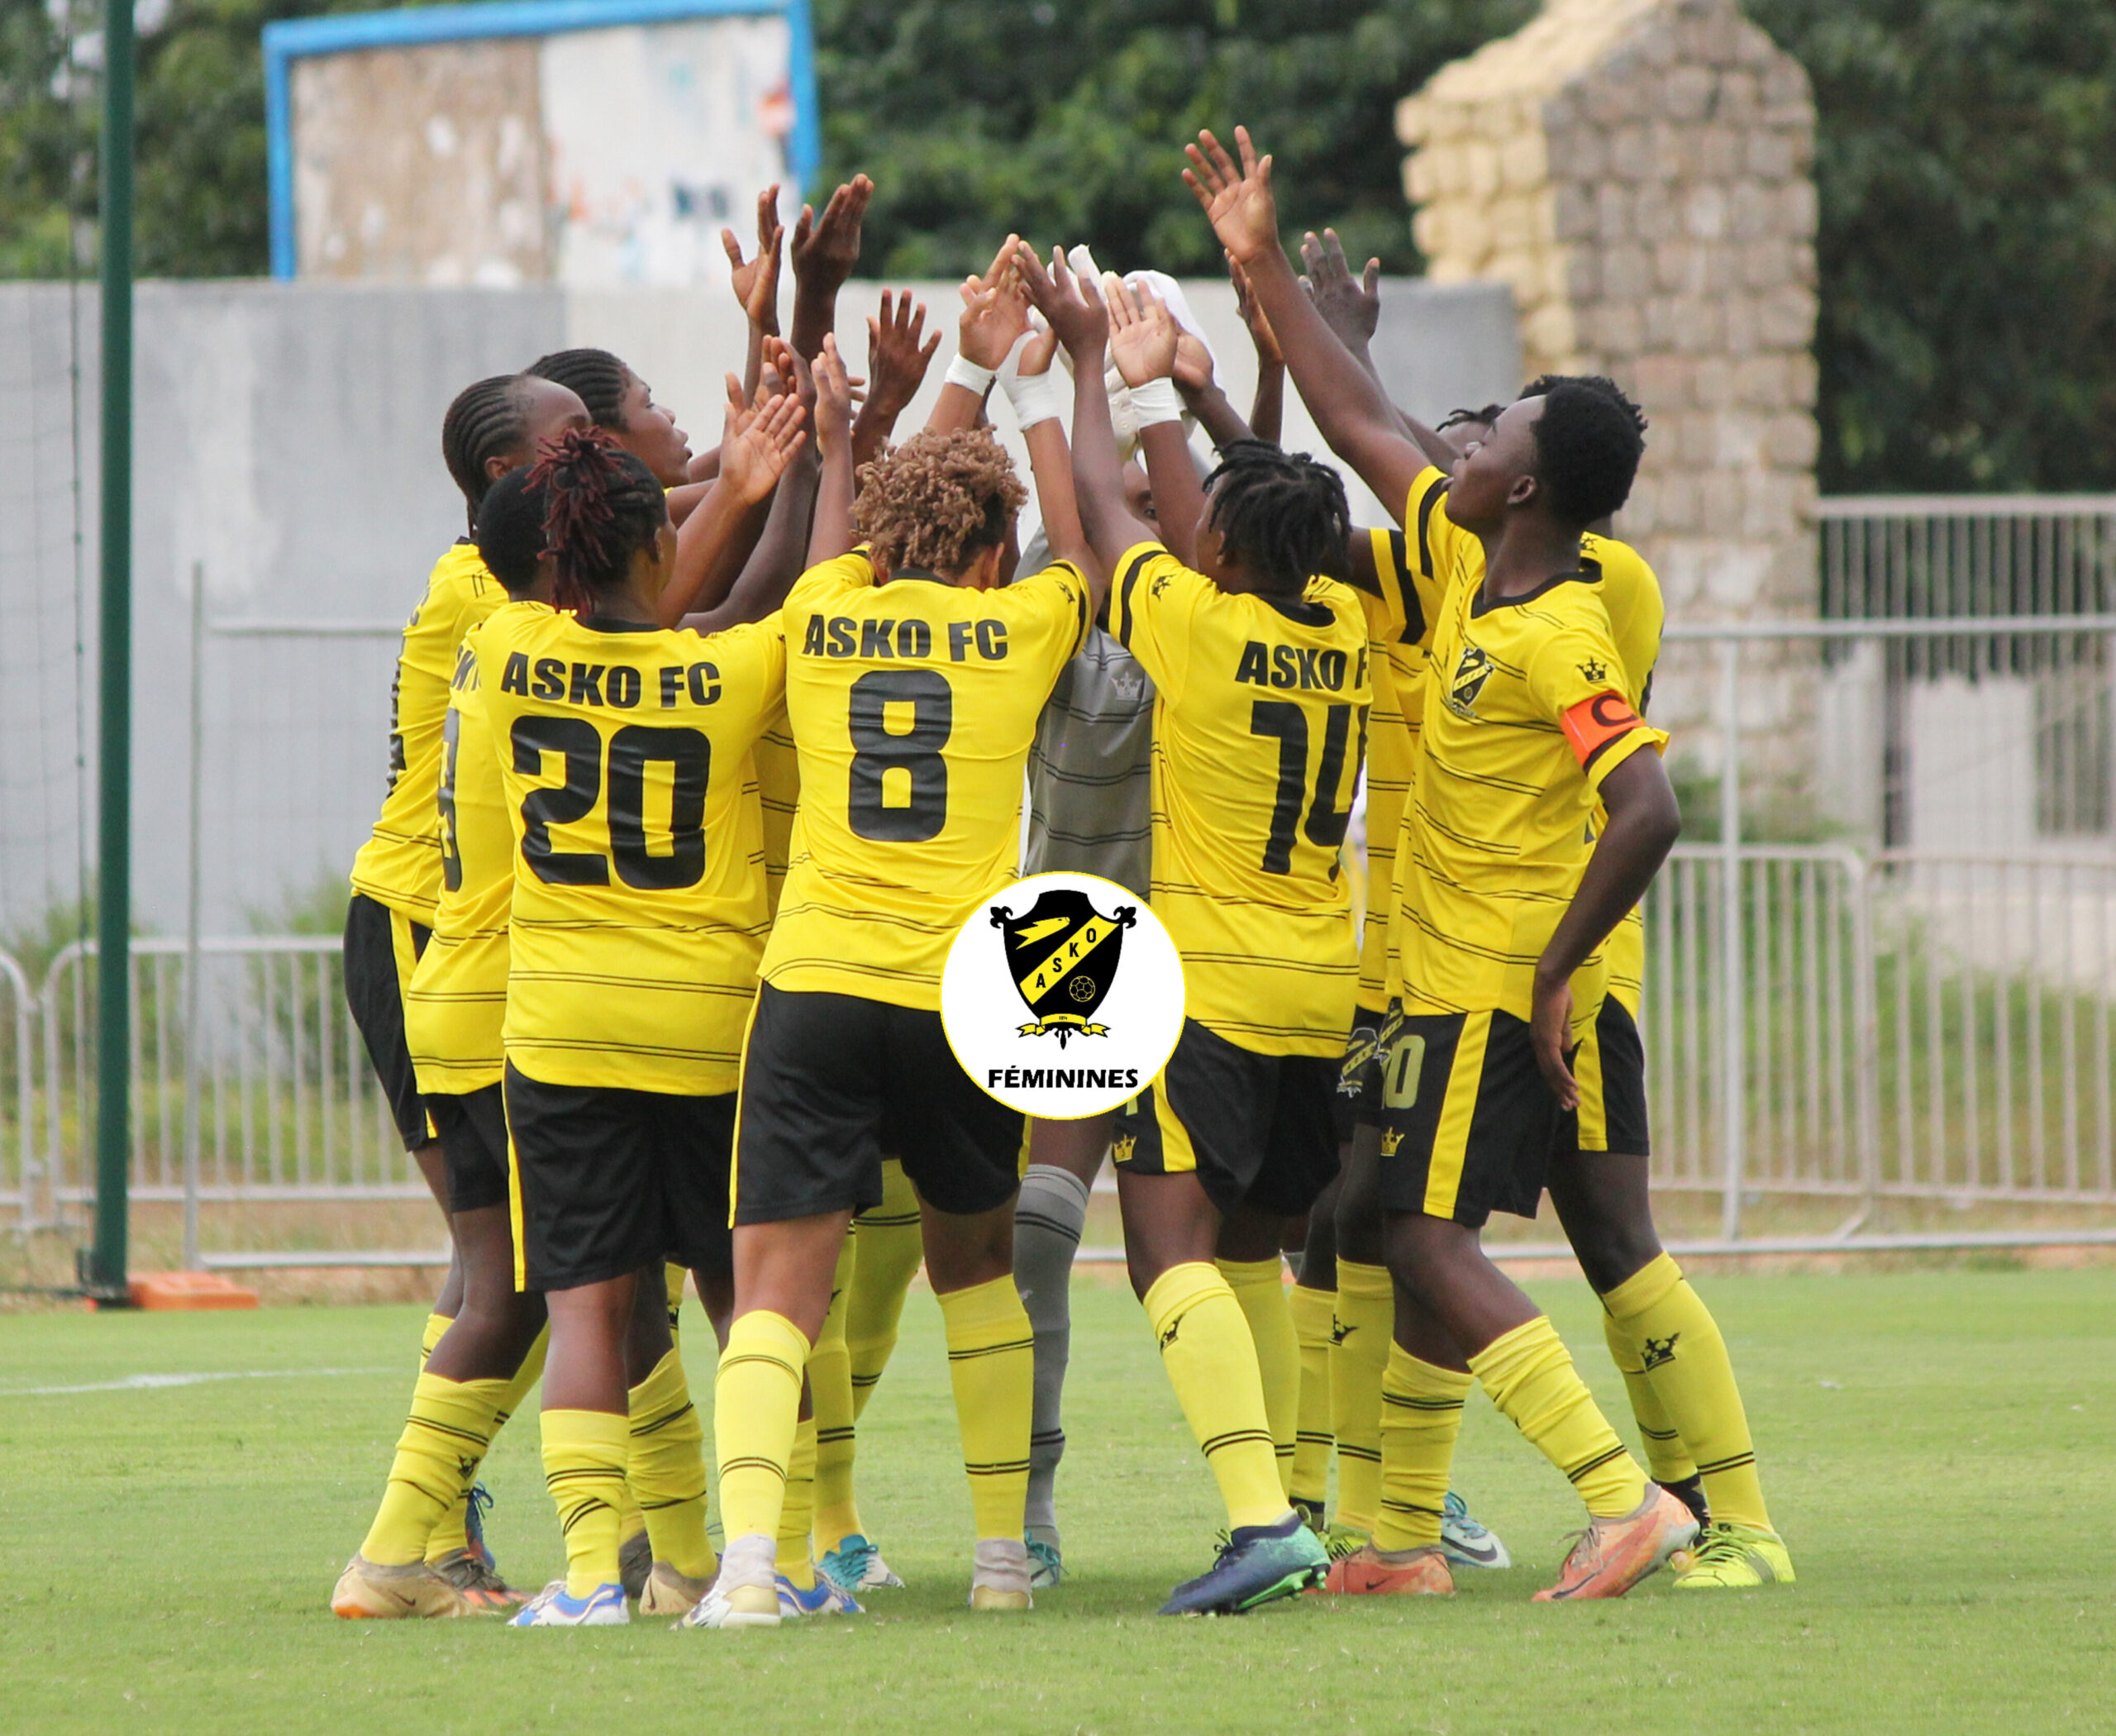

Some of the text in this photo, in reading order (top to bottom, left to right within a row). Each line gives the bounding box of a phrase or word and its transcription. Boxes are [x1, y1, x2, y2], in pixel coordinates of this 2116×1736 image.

[802, 614, 1008, 661] ASKO FC
[501, 652, 641, 708] ASKO
[659, 662, 722, 708] FC
[1235, 641, 1347, 691] ASKO
[1591, 694, 1637, 727] C
[848, 670, 952, 842] 8
[511, 715, 711, 890] 20
[1251, 700, 1370, 882] 14
